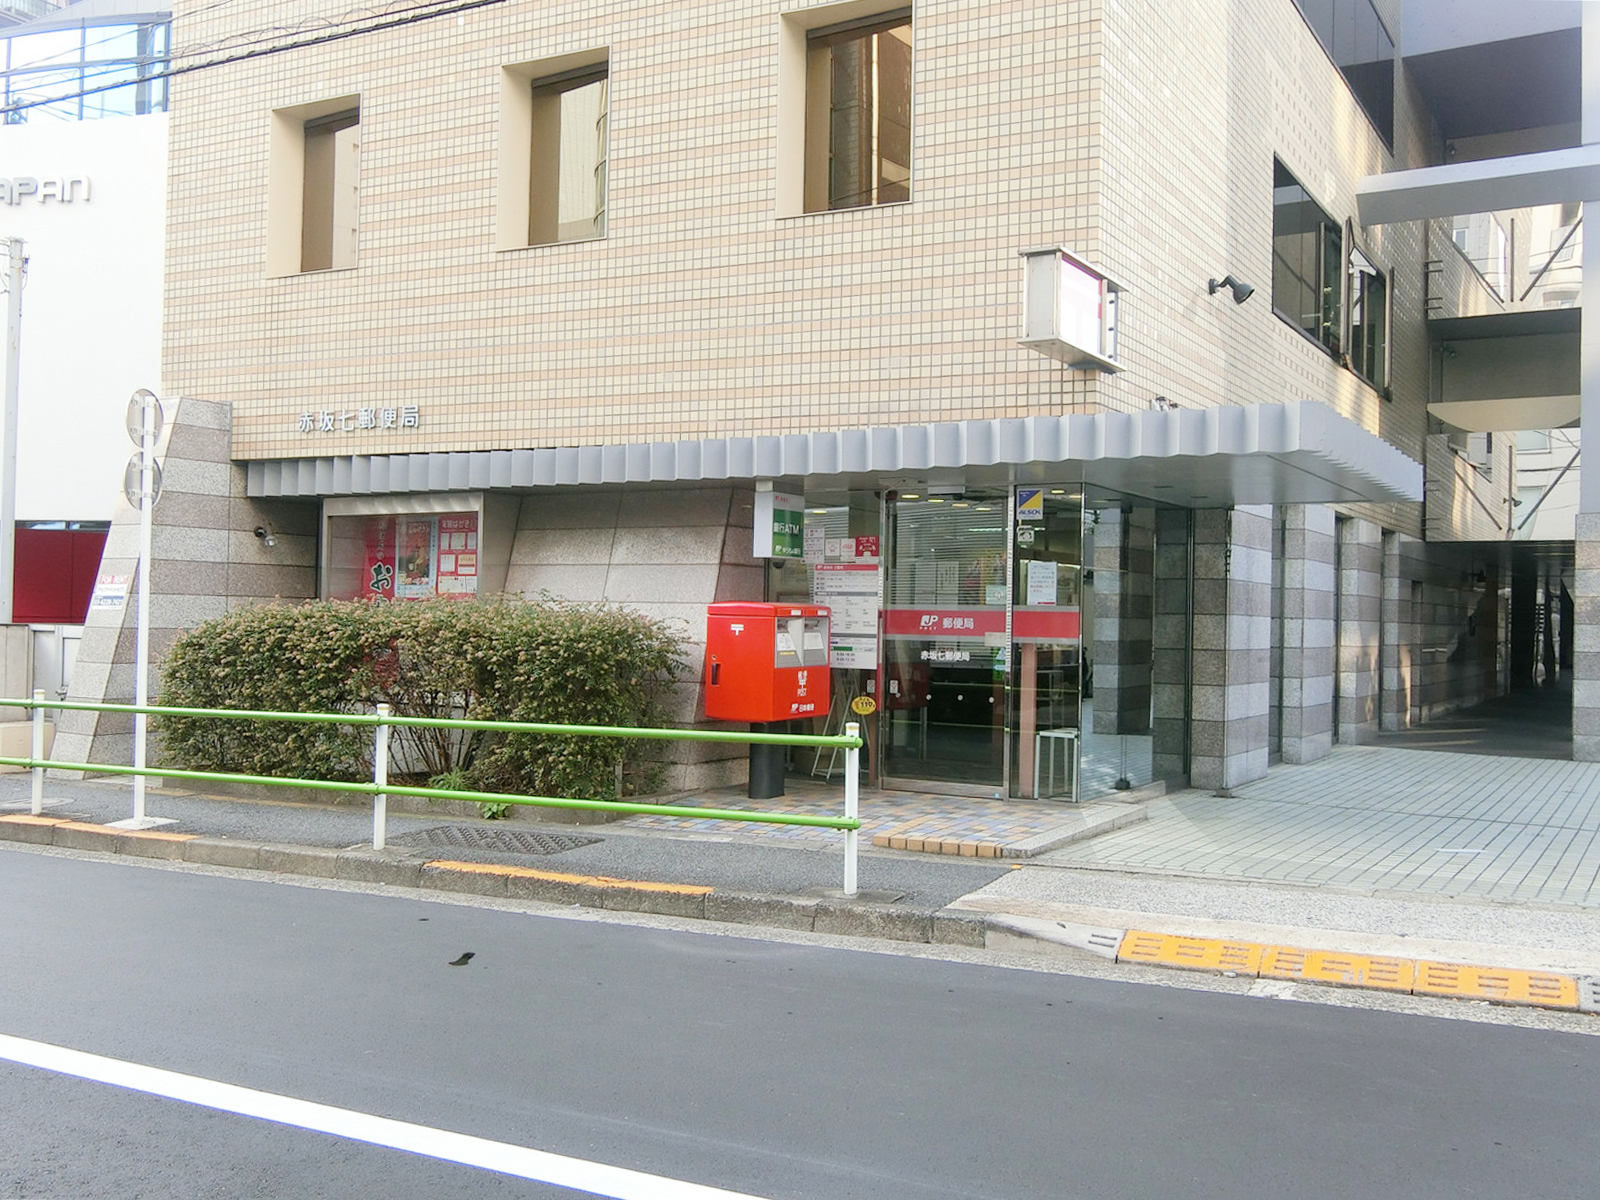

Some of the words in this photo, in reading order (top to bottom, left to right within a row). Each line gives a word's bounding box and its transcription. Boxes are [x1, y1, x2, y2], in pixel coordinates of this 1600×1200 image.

[299, 404, 419, 432] 赤坂七郵便局
[1018, 508, 1041, 516] ALSOK
[921, 614, 939, 627] JP
[942, 617, 975, 630] 郵便局
[920, 650, 971, 662] 赤坂七郵便局
